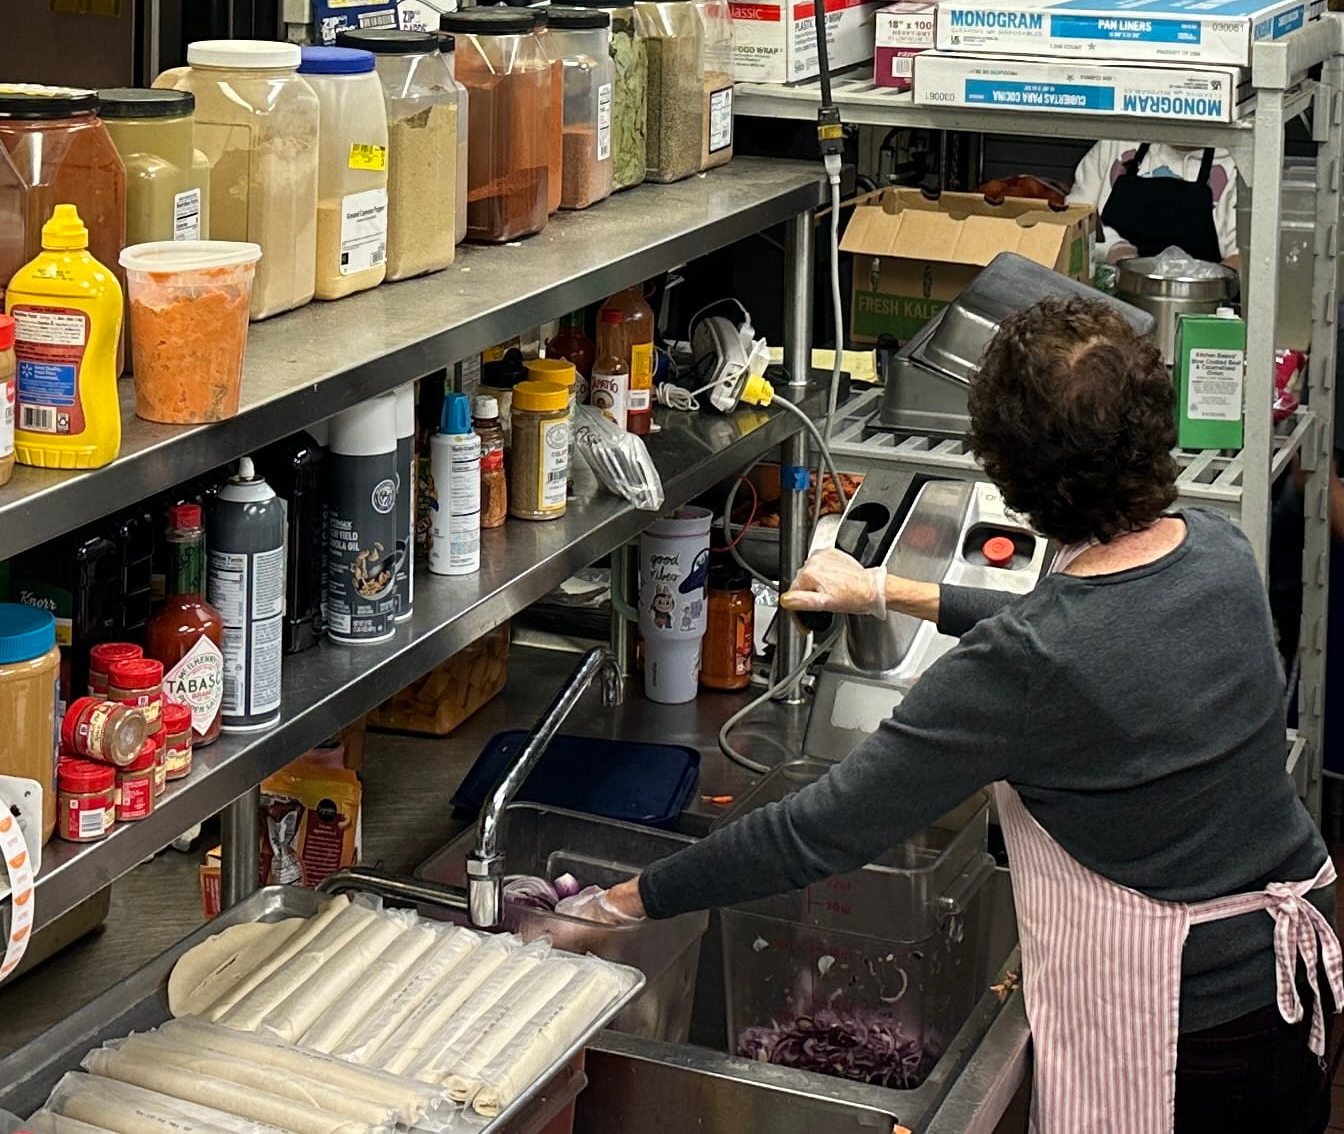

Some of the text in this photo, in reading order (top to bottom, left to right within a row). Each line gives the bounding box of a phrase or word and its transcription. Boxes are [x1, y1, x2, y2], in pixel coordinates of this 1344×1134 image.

[951, 10, 1043, 29] MONOGRAM
[1098, 19, 1153, 33] PAN LINERS
[756, 47, 779, 55] WRAP
[924, 91, 955, 102] 030061
[993, 90, 1087, 106] CUBIERTAS PARA COCINA
[1123, 94, 1222, 116] MONOGRAM
[859, 298, 938, 316] FRESH KALE
[339, 531, 359, 541] YIELD
[347, 542, 360, 551] OIL
[649, 553, 681, 568] good
[650, 567, 681, 581] vibes
[20, 590, 58, 611] Knorr
